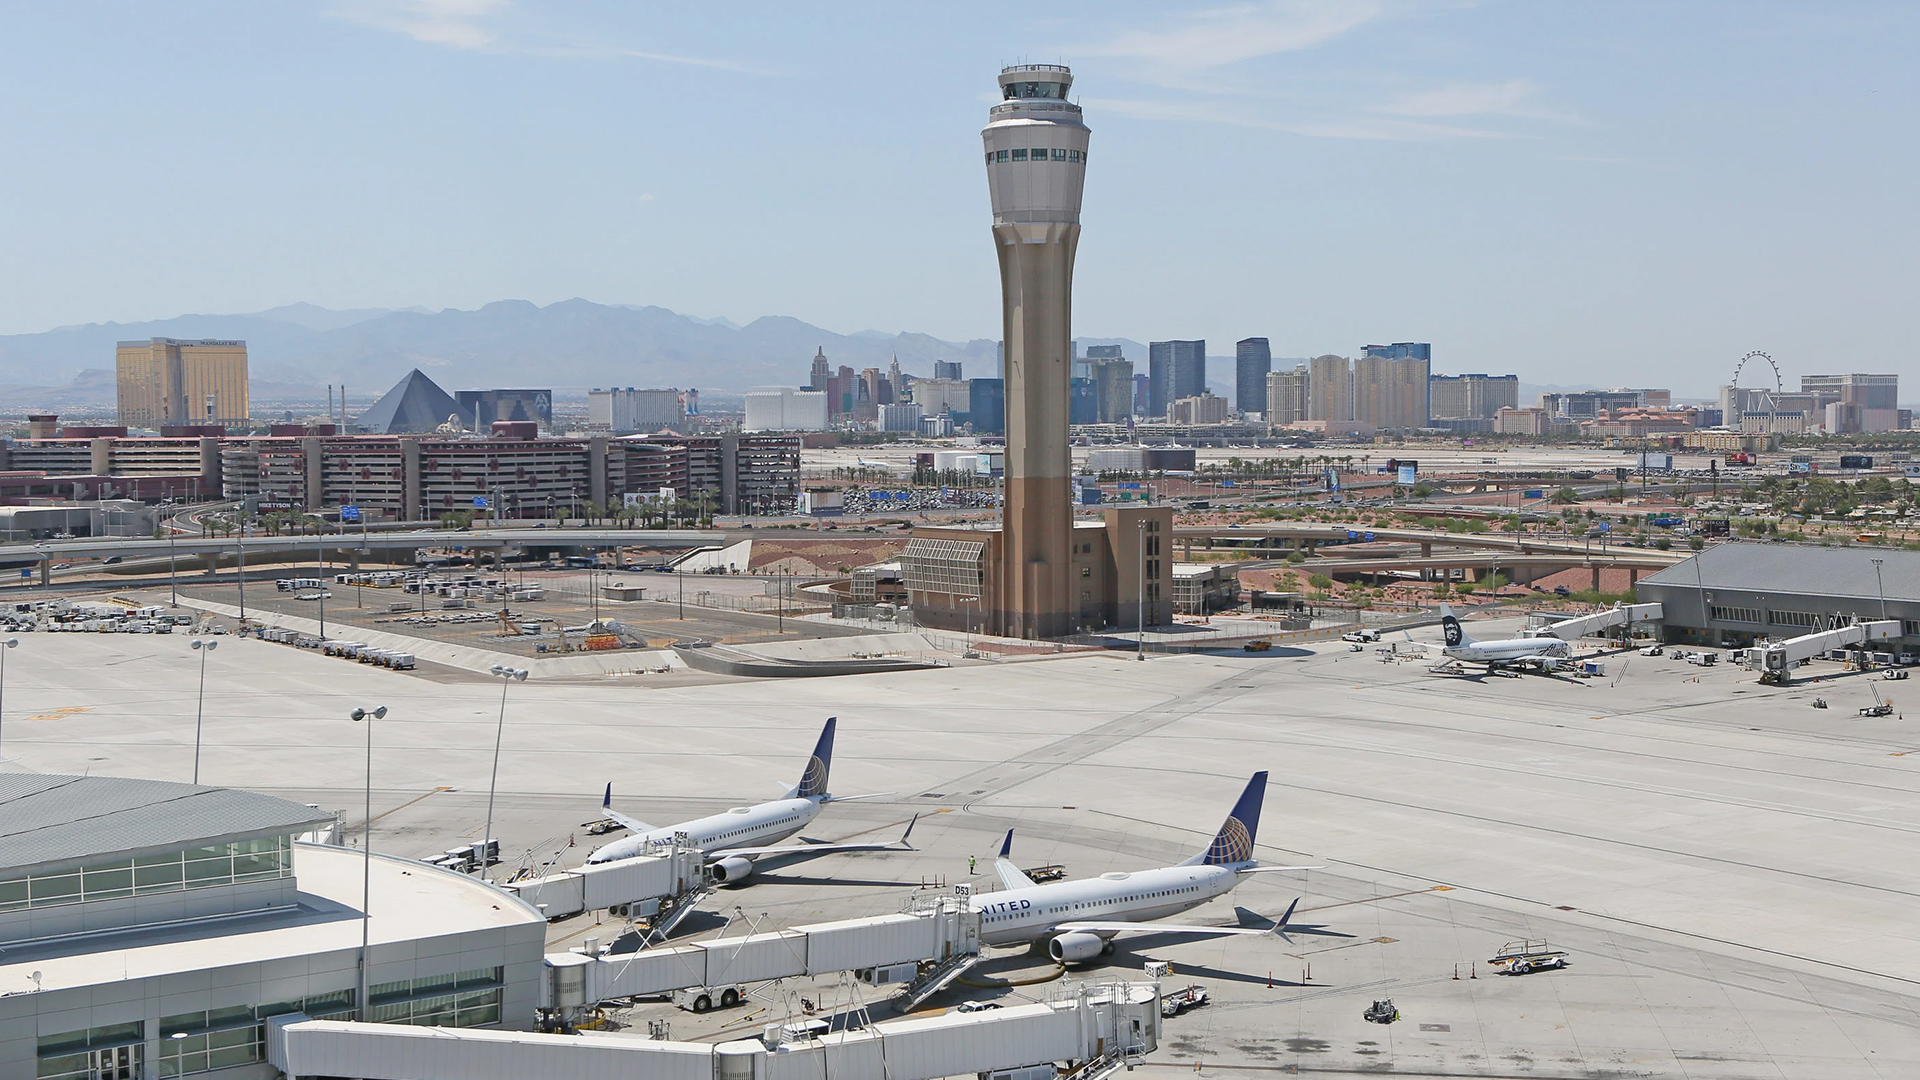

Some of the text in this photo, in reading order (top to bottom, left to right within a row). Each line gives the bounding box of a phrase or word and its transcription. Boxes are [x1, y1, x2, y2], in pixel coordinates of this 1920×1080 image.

[674, 831, 688, 840] D54
[955, 885, 970, 896] D53
[978, 899, 1031, 915] NITED
[1145, 964, 1155, 978] D52
[1156, 964, 1168, 978] D52
